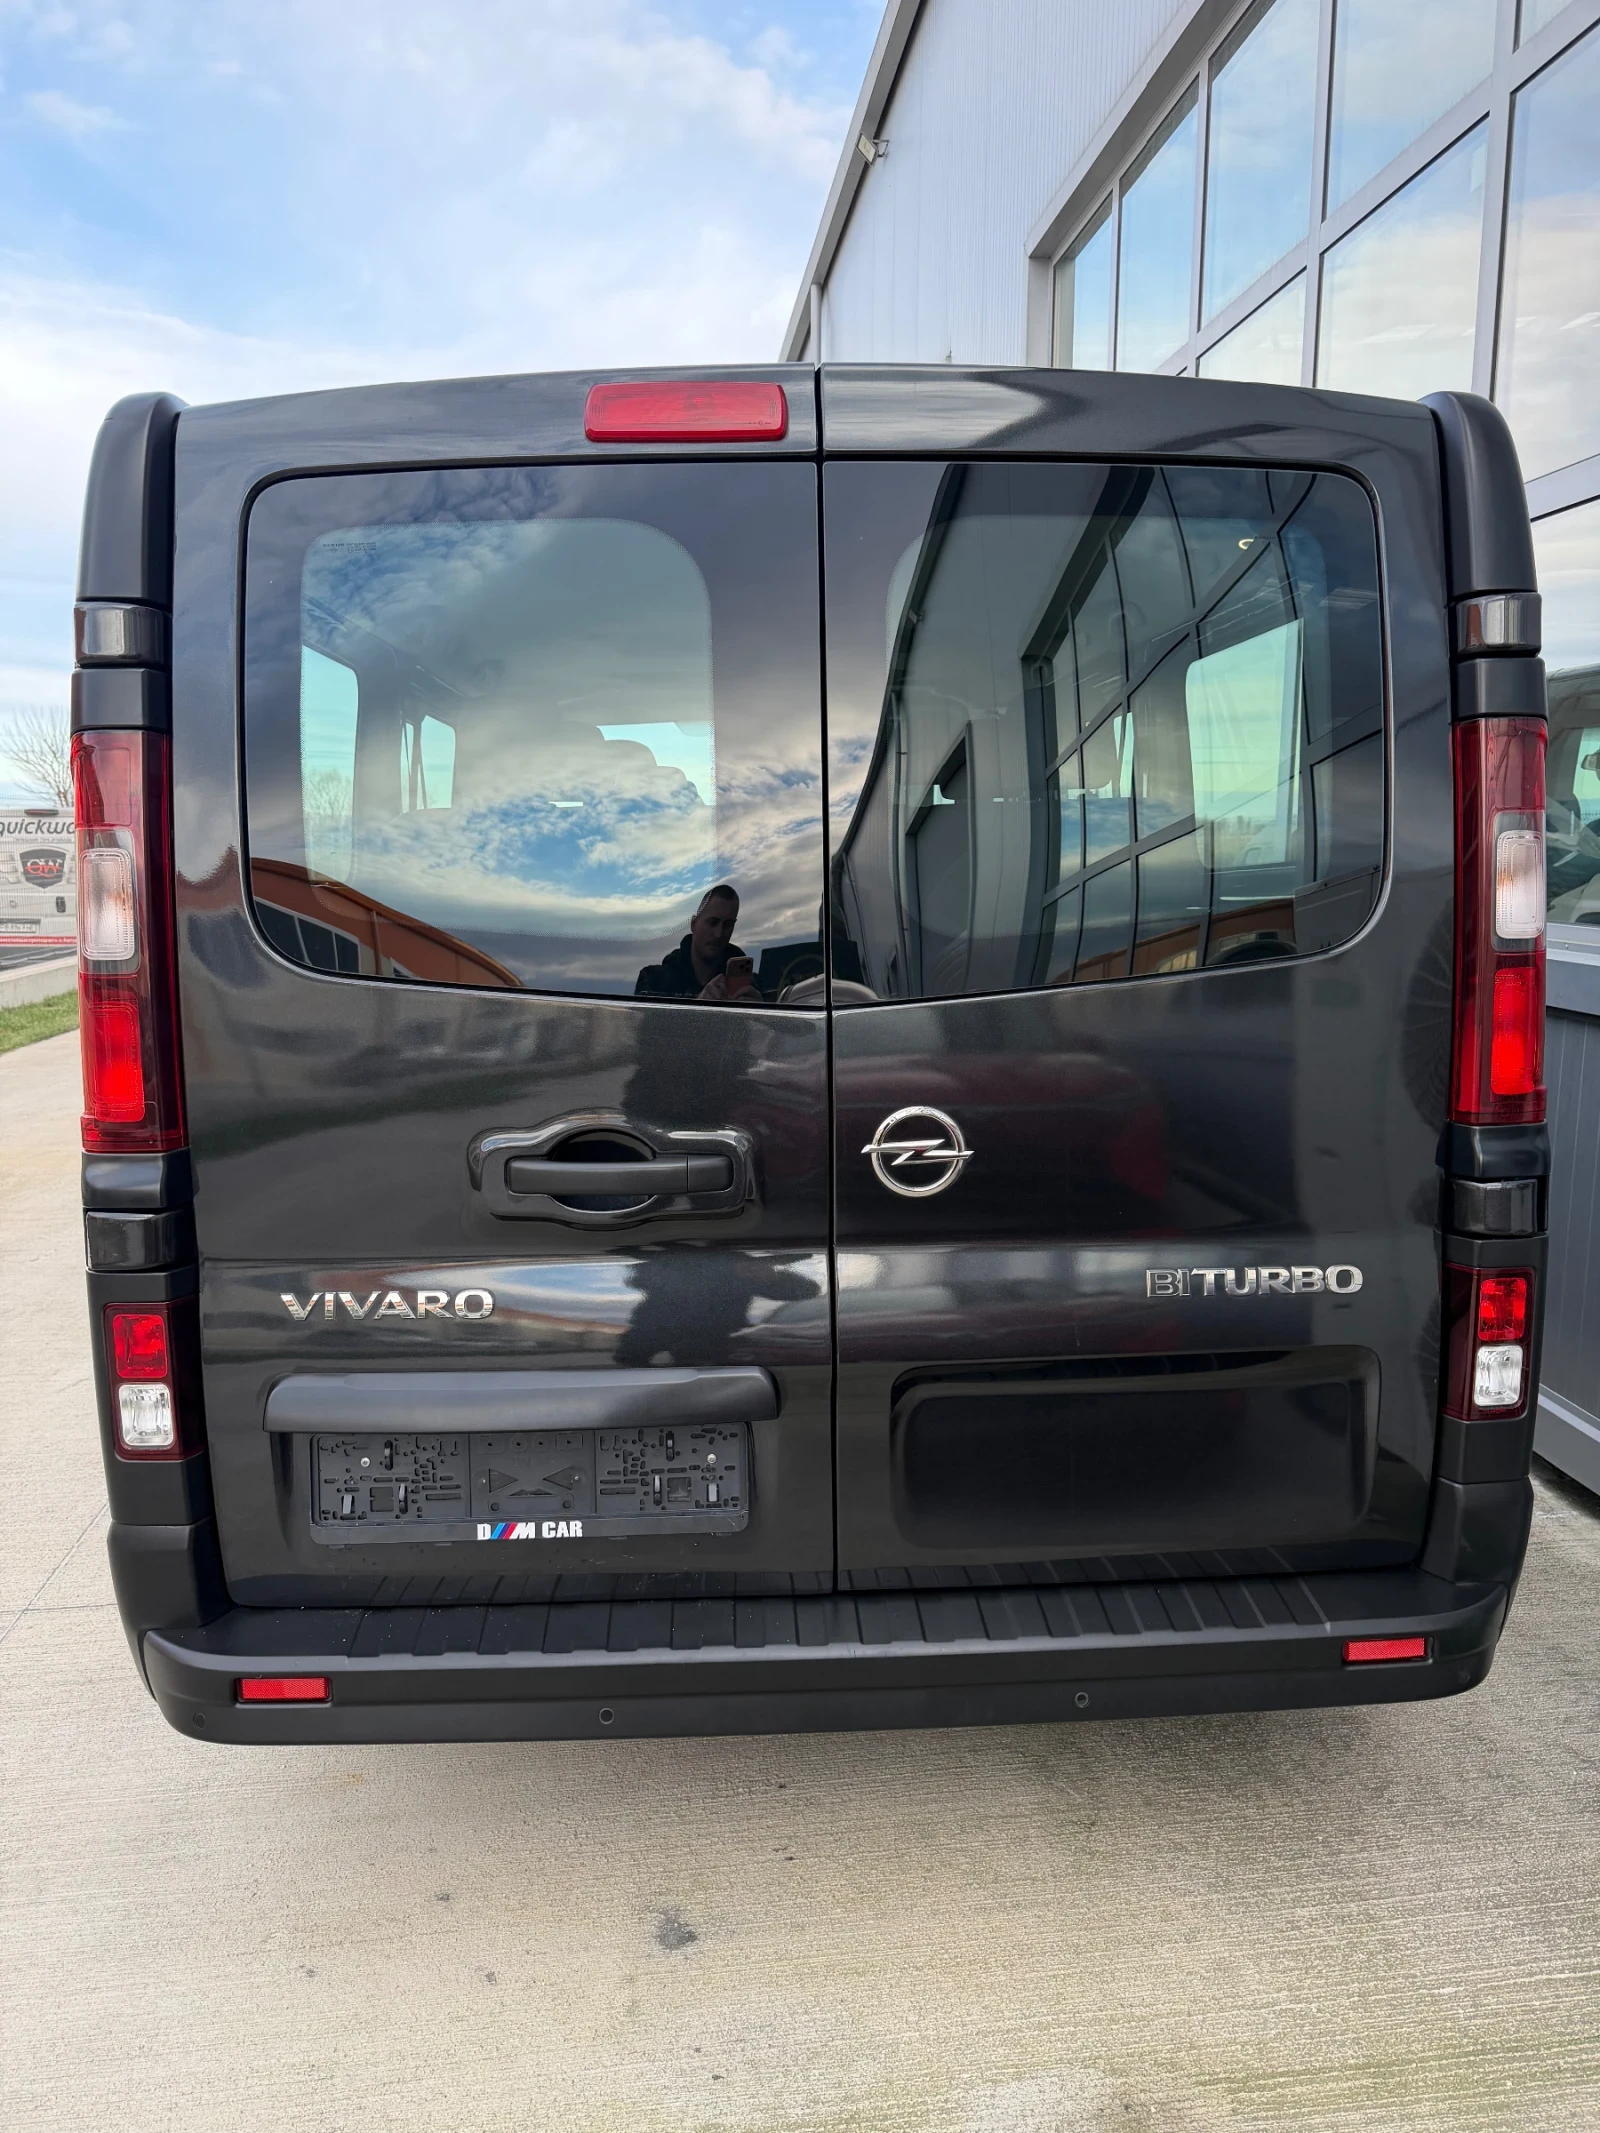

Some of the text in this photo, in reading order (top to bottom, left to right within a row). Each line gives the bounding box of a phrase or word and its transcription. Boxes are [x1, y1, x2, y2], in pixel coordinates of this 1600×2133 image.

[1146, 1264, 1364, 1298] BITURBO
[279, 1287, 496, 1321] VIVARO
[541, 1520, 583, 1539] CAR
